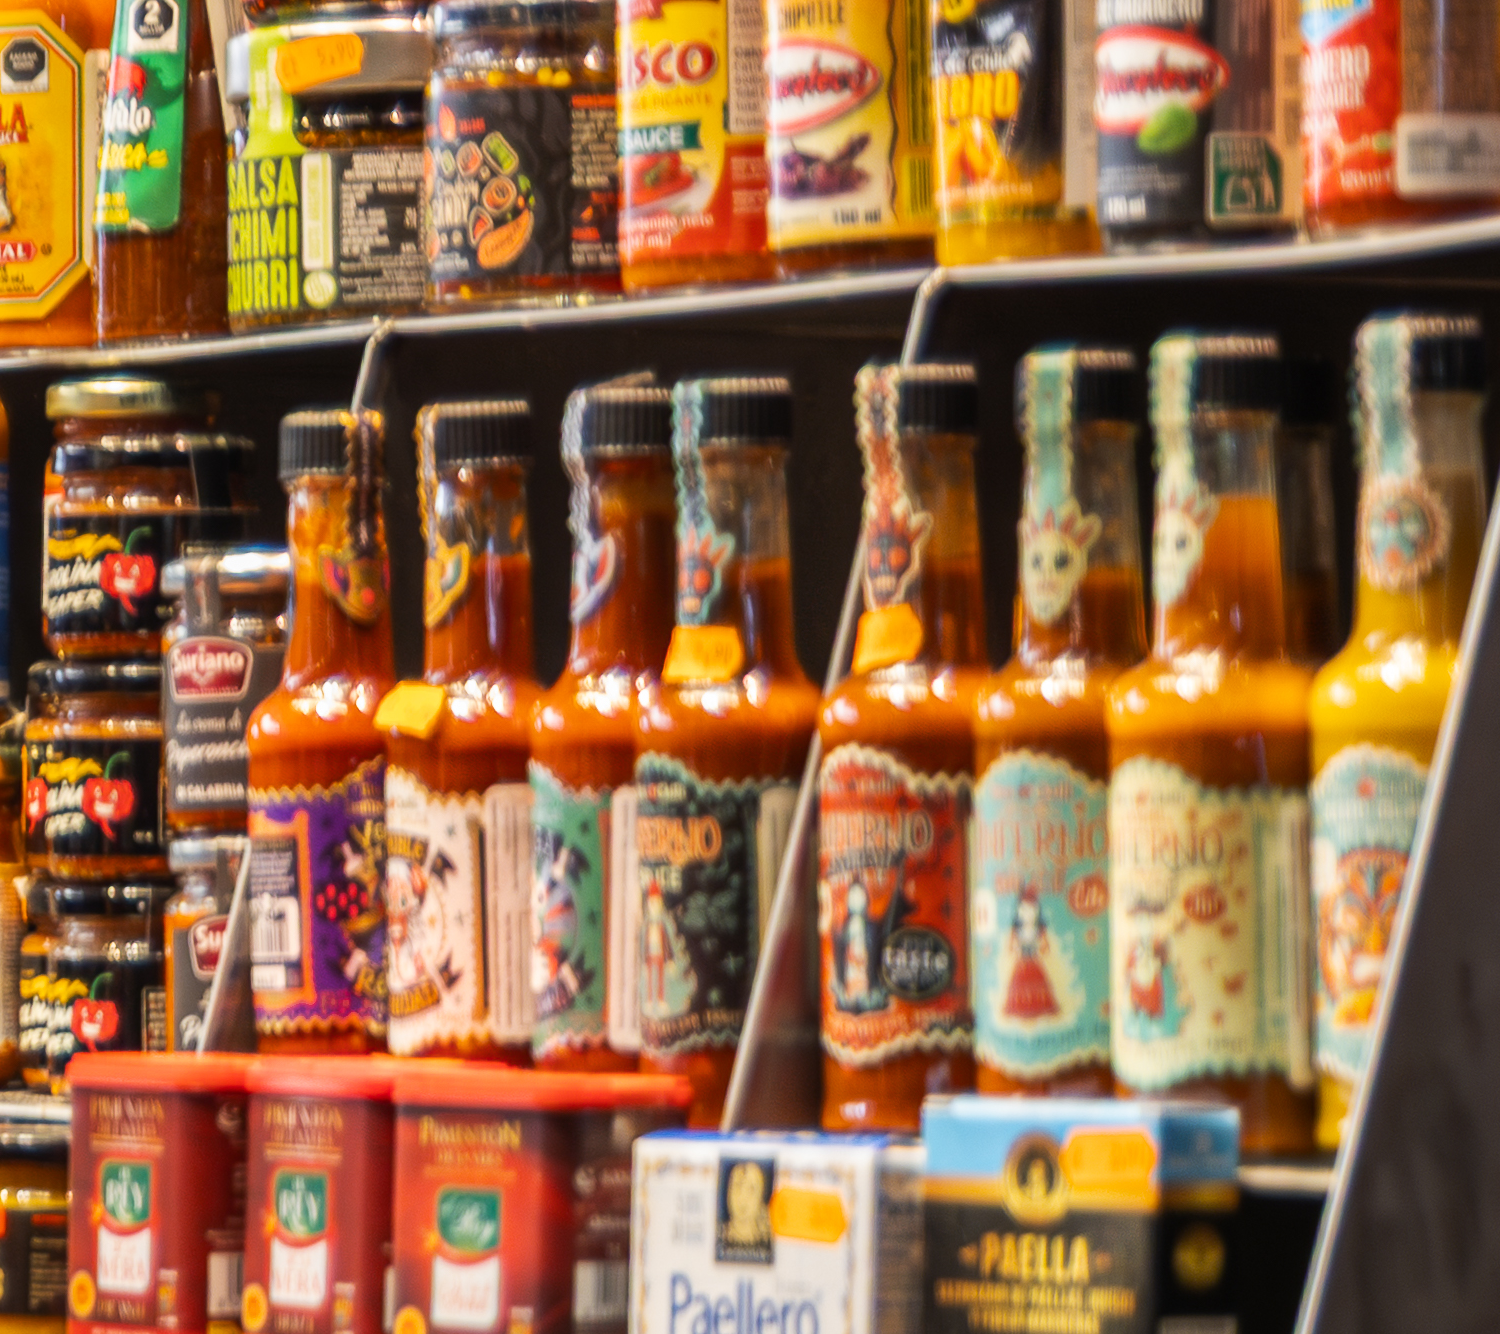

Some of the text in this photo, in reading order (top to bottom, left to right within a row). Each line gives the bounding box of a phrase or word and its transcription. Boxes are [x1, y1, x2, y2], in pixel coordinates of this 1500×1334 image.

[144, 0, 160, 24] 2
[229, 155, 299, 207] SALSA
[172, 648, 245, 675] Suriano
[978, 1230, 1092, 1283] PAELLA
